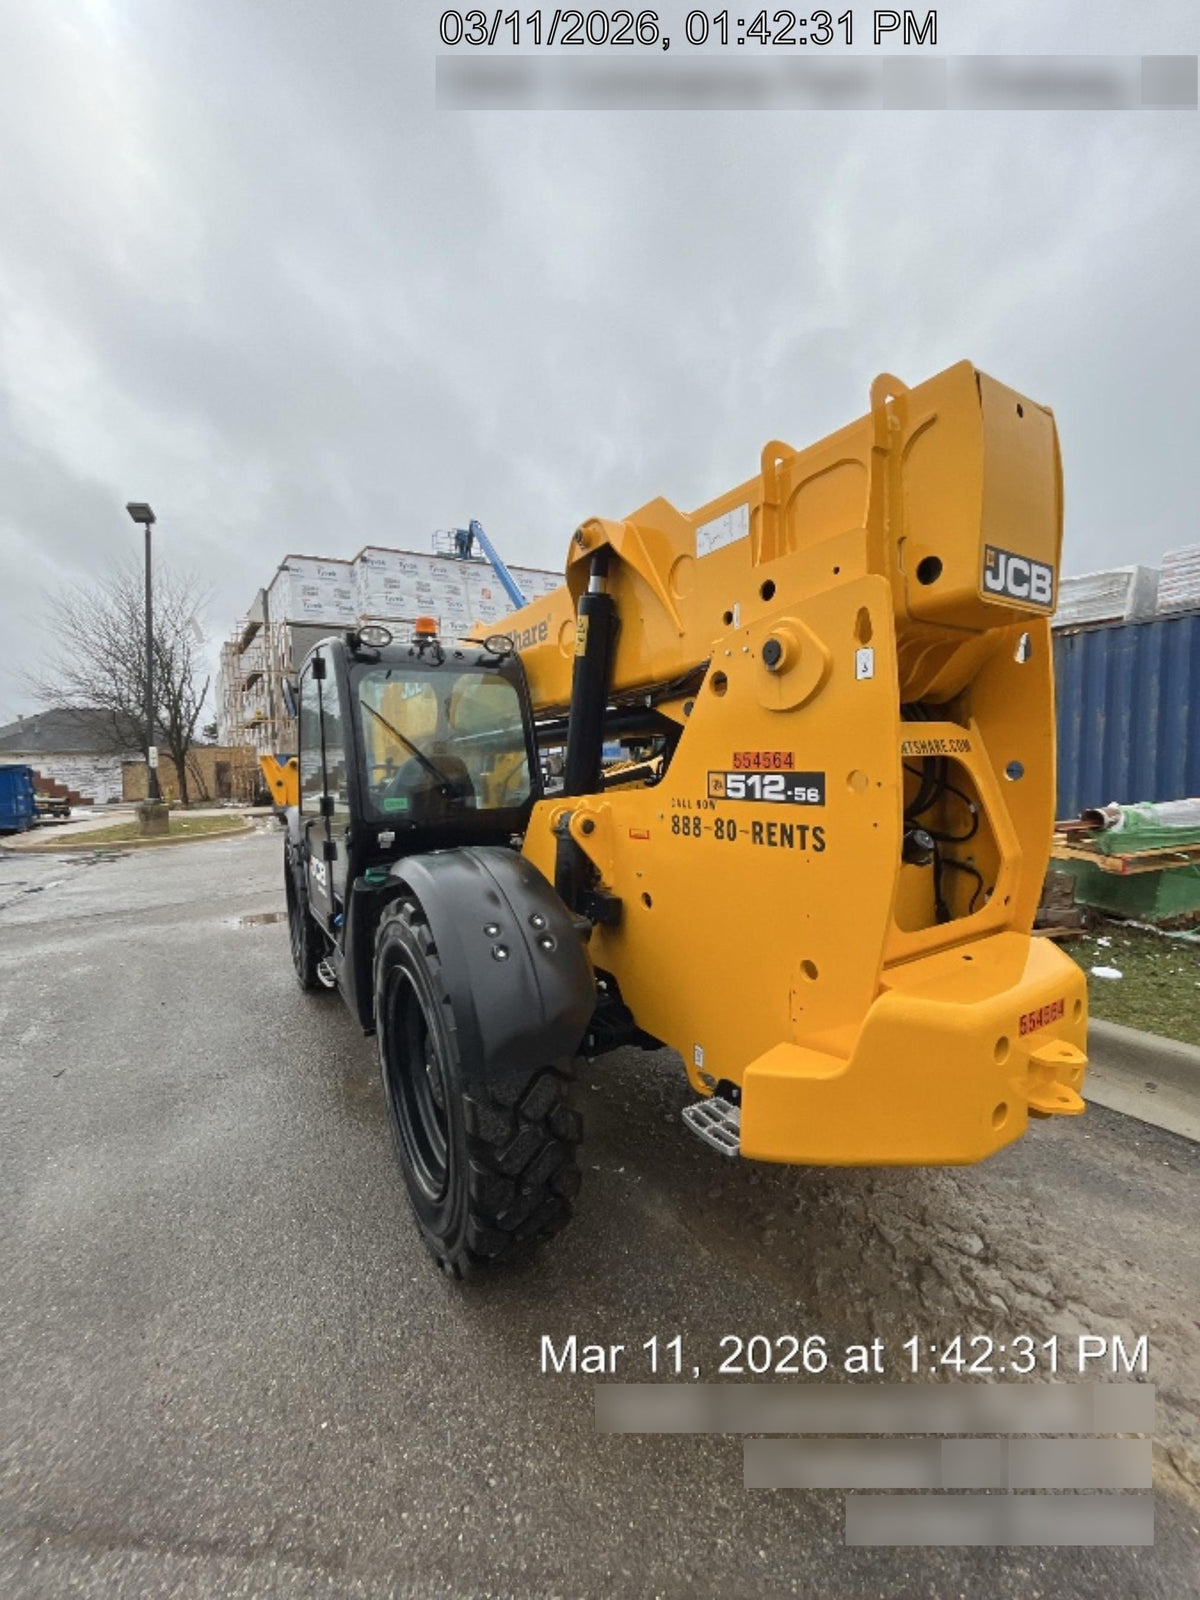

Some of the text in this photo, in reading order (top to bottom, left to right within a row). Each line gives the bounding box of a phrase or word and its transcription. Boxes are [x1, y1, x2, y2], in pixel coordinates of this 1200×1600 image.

[985, 553, 1052, 603] JCB
[733, 752, 793, 769] 554564
[671, 814, 826, 852] 888-80-RENTS
